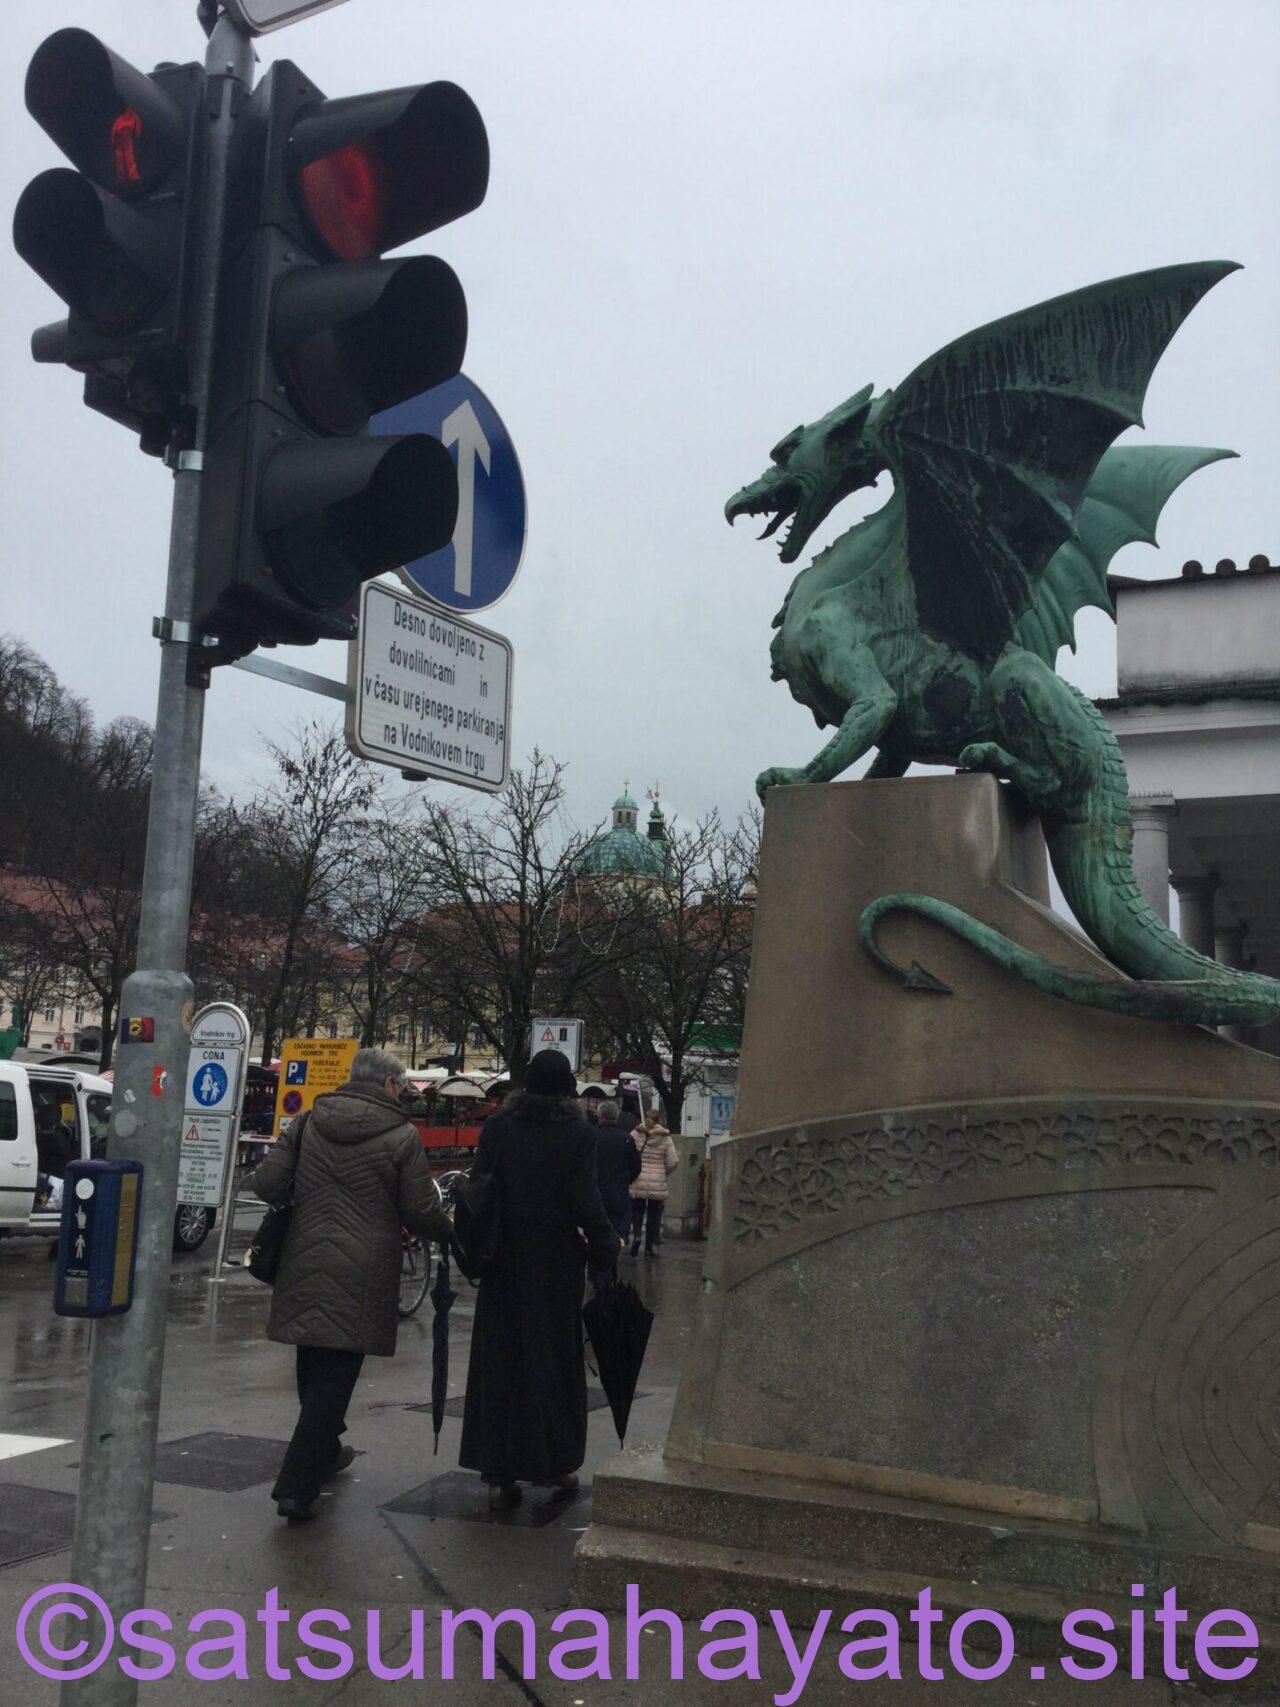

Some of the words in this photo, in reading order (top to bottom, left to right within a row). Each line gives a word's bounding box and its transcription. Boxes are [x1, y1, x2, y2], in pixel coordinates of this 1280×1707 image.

[394, 601, 426, 636] Desno
[429, 615, 476, 658] dovoljeno
[479, 644, 485, 661] z
[389, 640, 456, 686] dovolilnicami
[479, 674, 488, 699] in
[365, 675, 372, 696] v
[374, 673, 400, 706] času
[403, 690, 454, 728] urejenega
[456, 708, 504, 745] parkiranja
[384, 723, 397, 745] na
[401, 722, 462, 763] Vodnikovem
[465, 746, 485, 776] trgu
[200, 1030, 225, 1038] Vodnikov
[226, 1031, 236, 1039] trg
[202, 1050, 225, 1060] CONA
[288, 1062, 299, 1077] P
